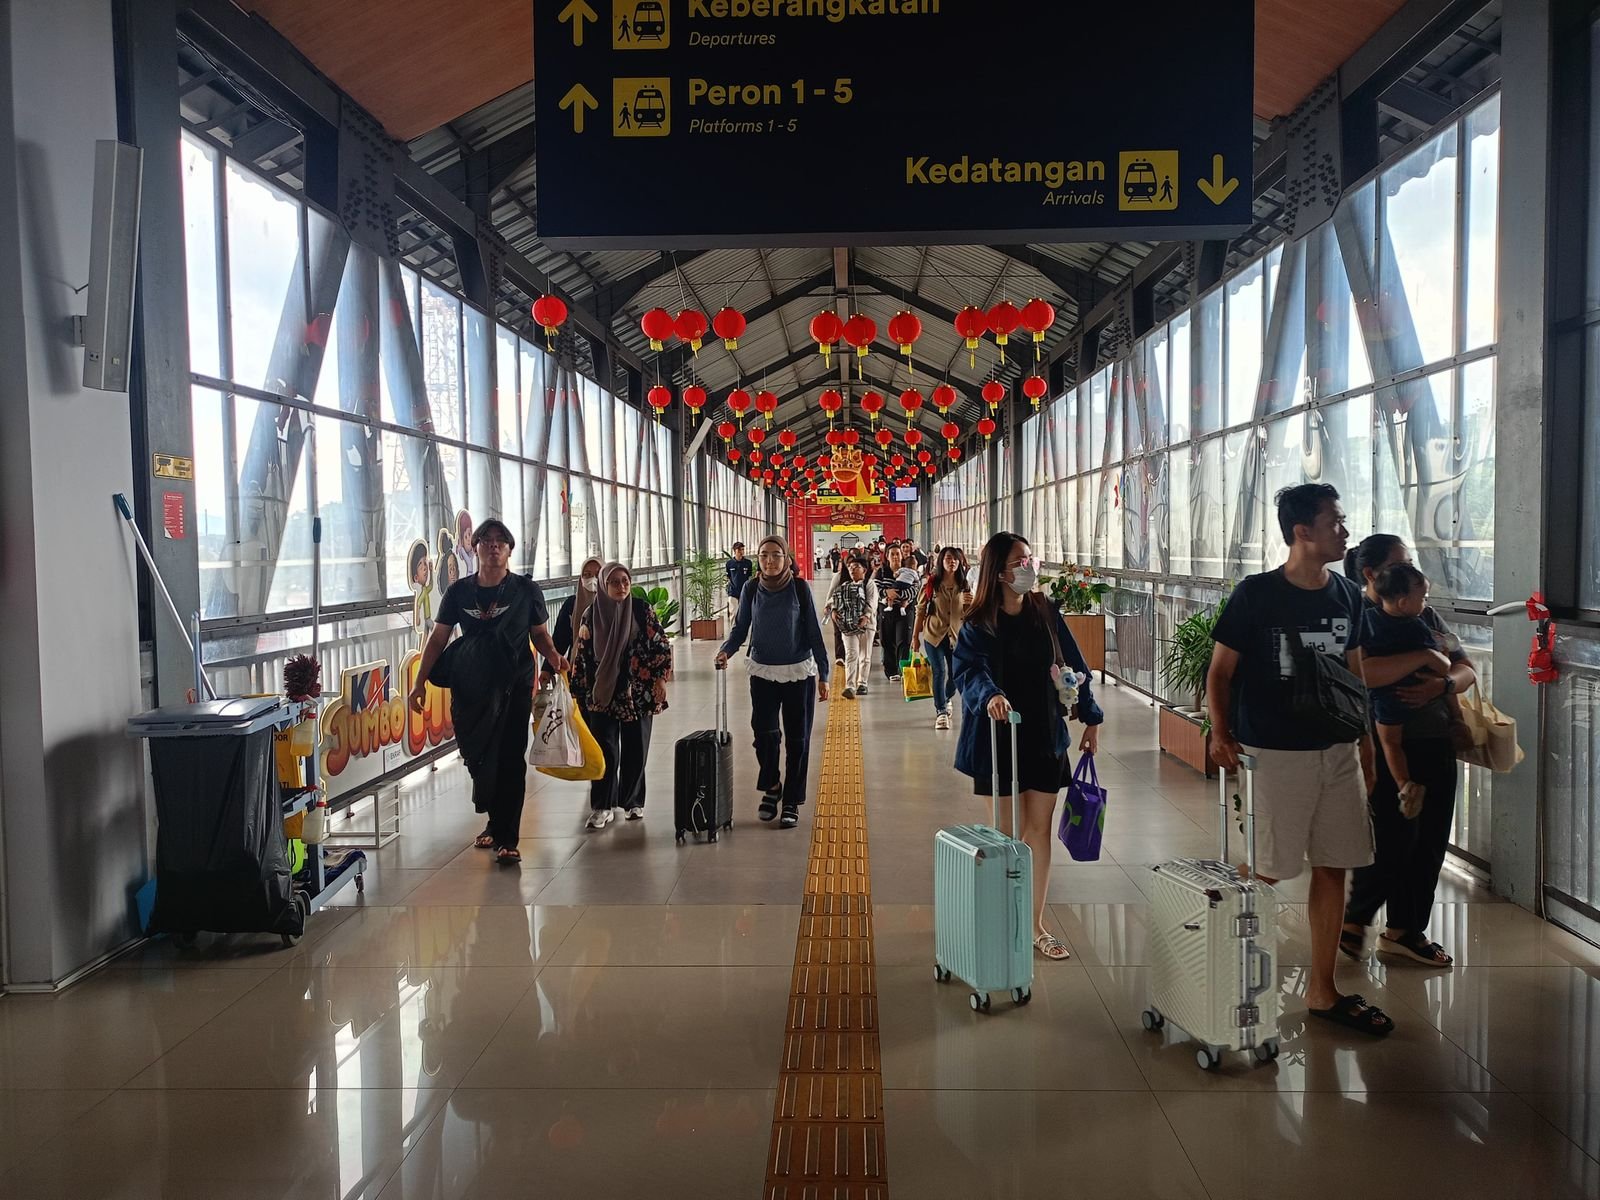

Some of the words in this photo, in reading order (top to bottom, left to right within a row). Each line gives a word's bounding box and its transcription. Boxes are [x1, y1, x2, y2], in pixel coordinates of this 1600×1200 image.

[688, 0, 941, 23] Keberangkatan
[689, 31, 777, 49] Departures
[688, 78, 782, 106] Peron
[791, 79, 805, 105] 1
[813, 88, 826, 96] -
[833, 78, 854, 105] 5
[689, 118, 764, 134] Platforms
[767, 119, 775, 133] 1
[787, 118, 798, 132] 5
[906, 155, 1105, 188] Kedatangan
[1042, 190, 1105, 206] Arrivals
[351, 665, 390, 714] KAI
[326, 695, 406, 777] JUMBO
